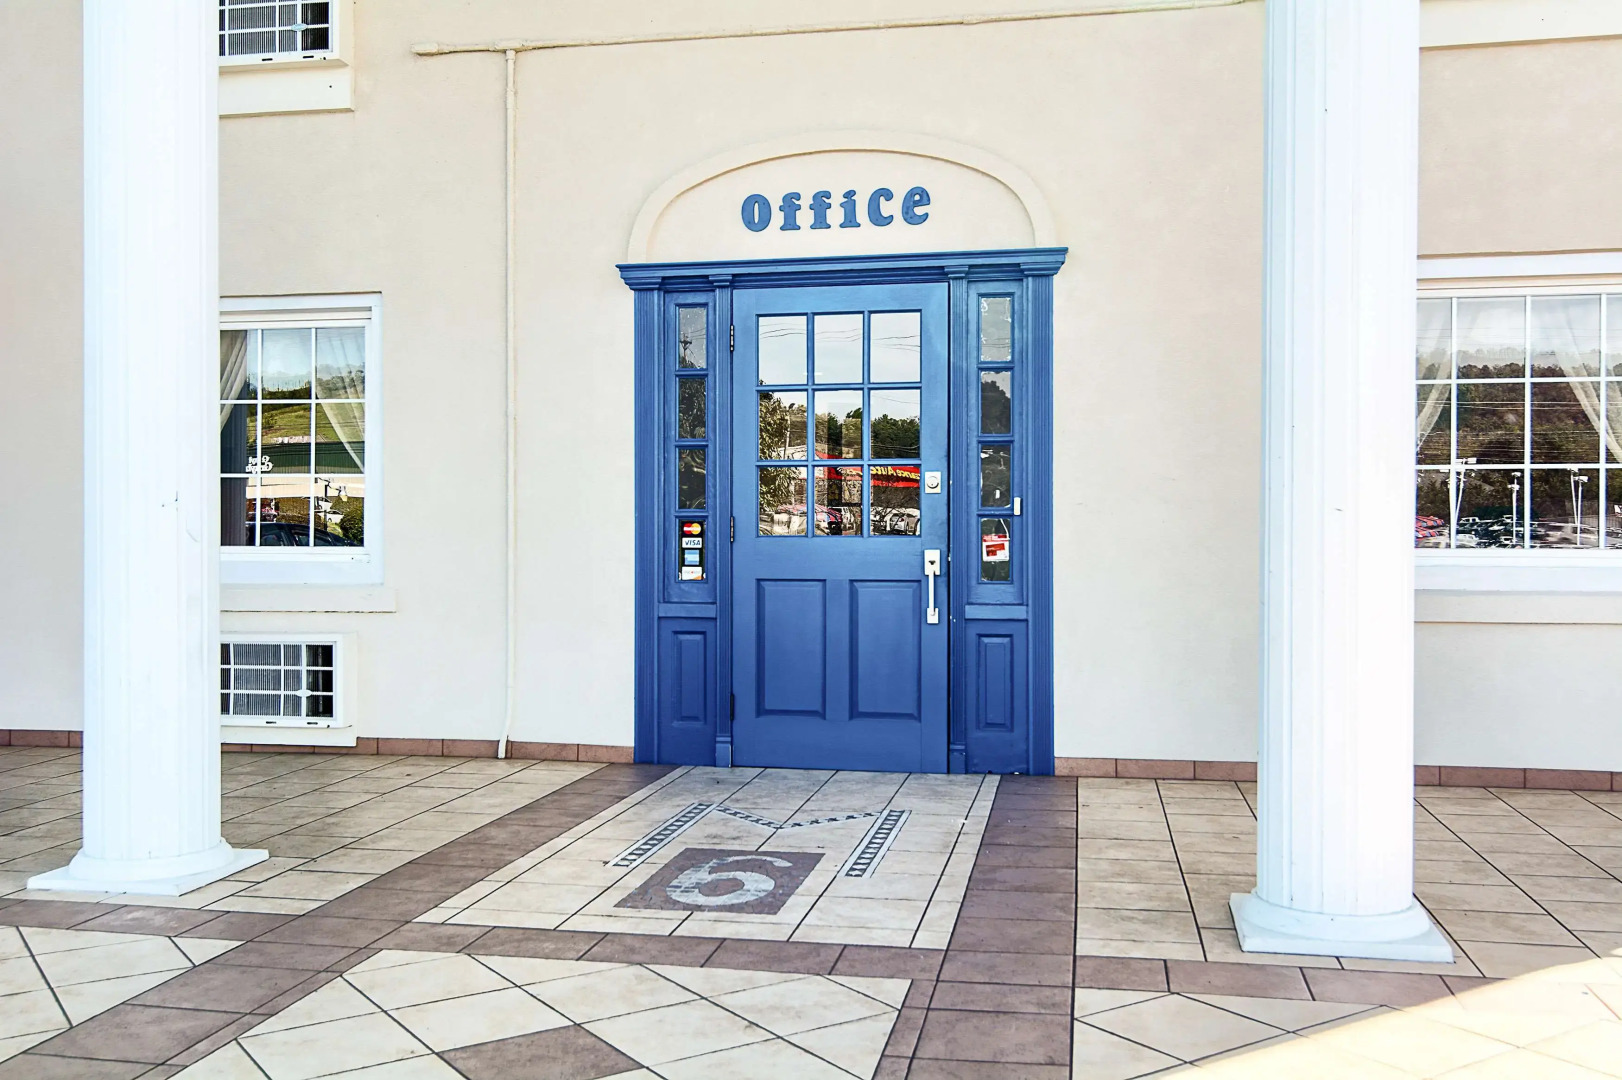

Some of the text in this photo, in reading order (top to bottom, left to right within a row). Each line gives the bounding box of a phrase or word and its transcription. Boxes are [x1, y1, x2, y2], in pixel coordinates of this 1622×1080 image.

[741, 186, 931, 232] Office
[684, 539, 701, 547] VISA
[665, 855, 793, 906] 6
